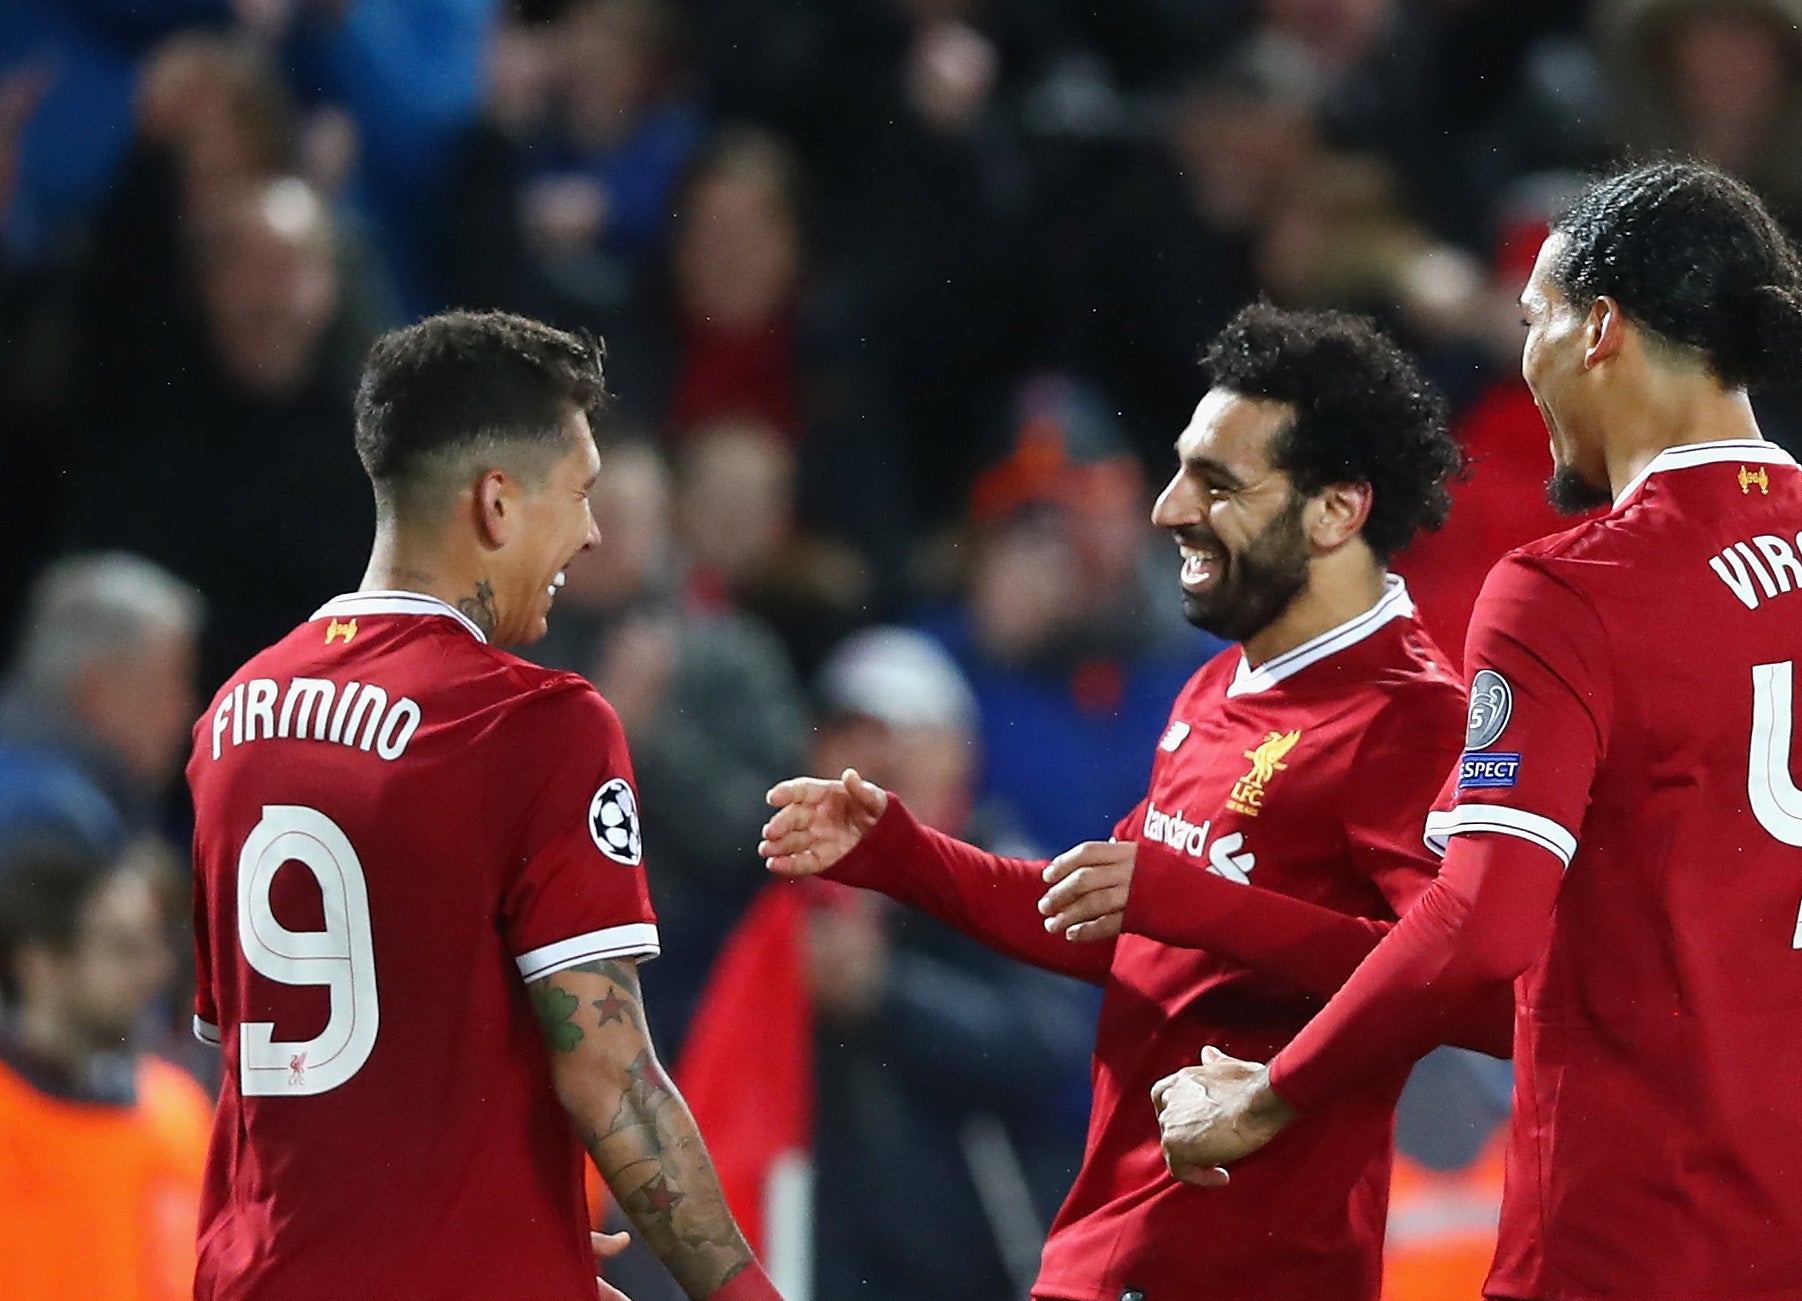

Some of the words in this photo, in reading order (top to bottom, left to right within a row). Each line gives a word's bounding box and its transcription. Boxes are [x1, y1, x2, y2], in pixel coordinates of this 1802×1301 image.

[211, 675, 422, 762] FIRMINO
[1230, 781, 1265, 807] LFC
[1460, 761, 1519, 779] SPECT
[1143, 801, 1211, 857] tandard
[236, 803, 380, 1098] 9
